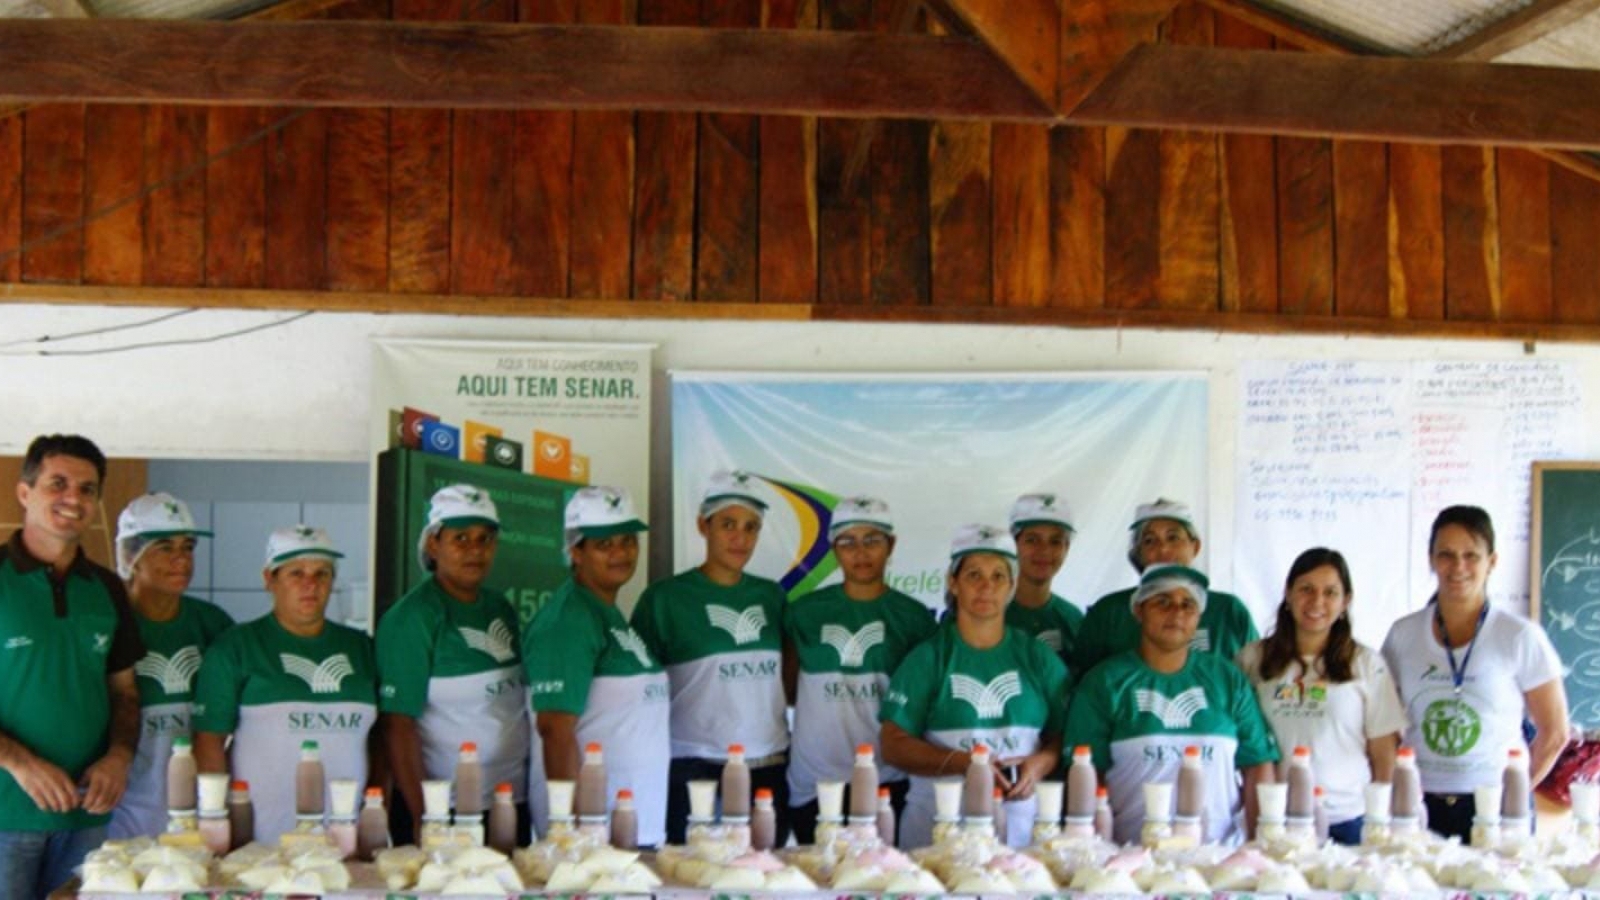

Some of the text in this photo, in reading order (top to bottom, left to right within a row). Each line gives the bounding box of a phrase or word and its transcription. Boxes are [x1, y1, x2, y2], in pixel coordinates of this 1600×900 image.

[457, 375, 640, 399] AQUI TEM SENAR.
[719, 659, 777, 678] SENAR
[146, 713, 185, 732] SEN
[288, 711, 363, 730] SENAR
[1143, 745, 1214, 762] SENR
